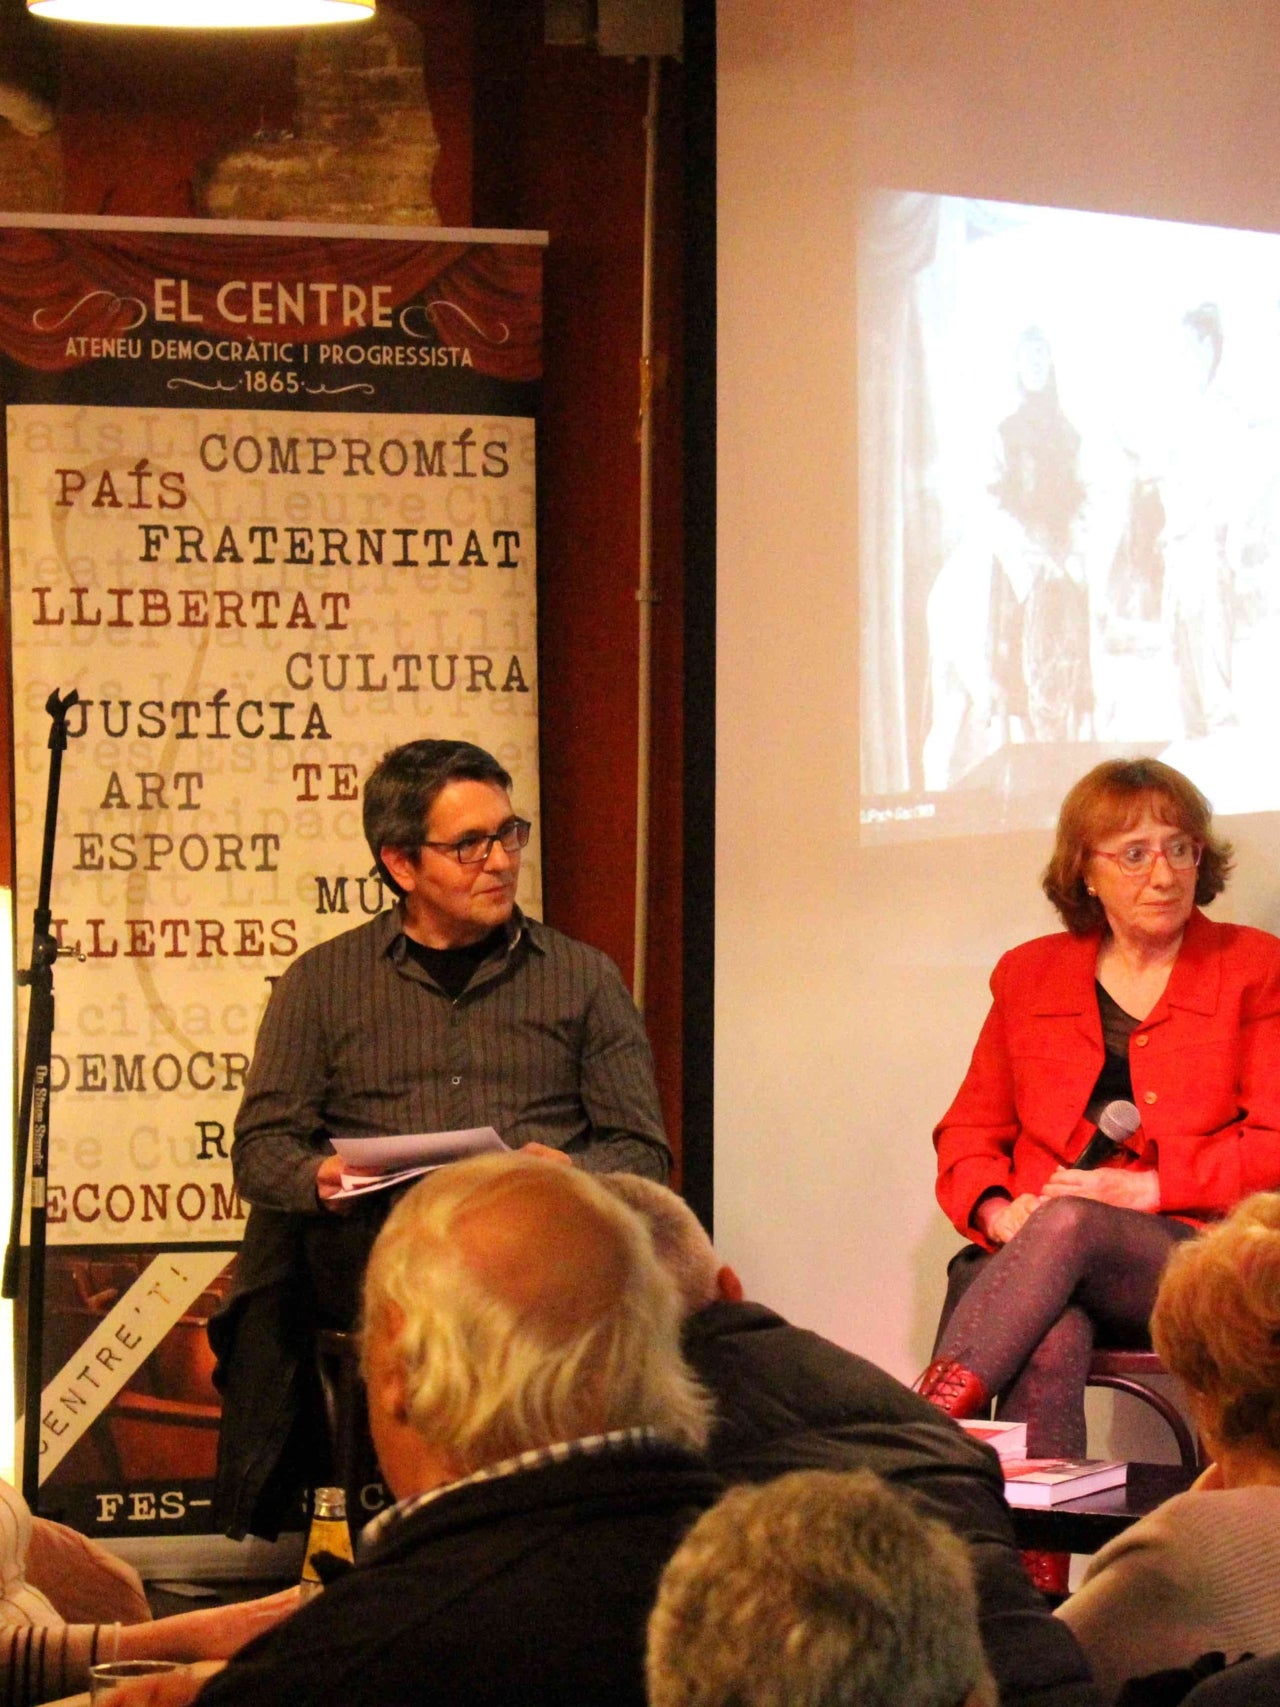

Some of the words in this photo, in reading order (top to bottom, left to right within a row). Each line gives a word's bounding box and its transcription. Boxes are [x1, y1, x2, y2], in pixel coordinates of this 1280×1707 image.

[154, 279, 203, 324] EL
[216, 280, 393, 328] CENTRE
[65, 337, 142, 360] ATENEU
[151, 336, 293, 364] DEMOCRÀTIC
[303, 343, 309, 364] I
[319, 344, 473, 368] PROGRESSISTA
[201, 427, 510, 478] COMPROMÍS
[54, 458, 187, 510] PAÍS
[138, 524, 520, 568] FRATERNITAT
[32, 587, 350, 630] LLIBERTAT
[286, 653, 529, 693] CULTURA
[63, 689, 332, 740] JUSTÍCIA
[100, 771, 204, 811] ART
[293, 763, 358, 801] TE
[72, 832, 280, 873] ESPORT
[315, 867, 400, 915] MÚ
[52, 918, 298, 958] LLETRES
[51, 1052, 250, 1092] DEMOCR
[195, 1121, 228, 1159] R
[46, 1183, 246, 1223] ECONOM
[96, 1493, 212, 1522] FES-
